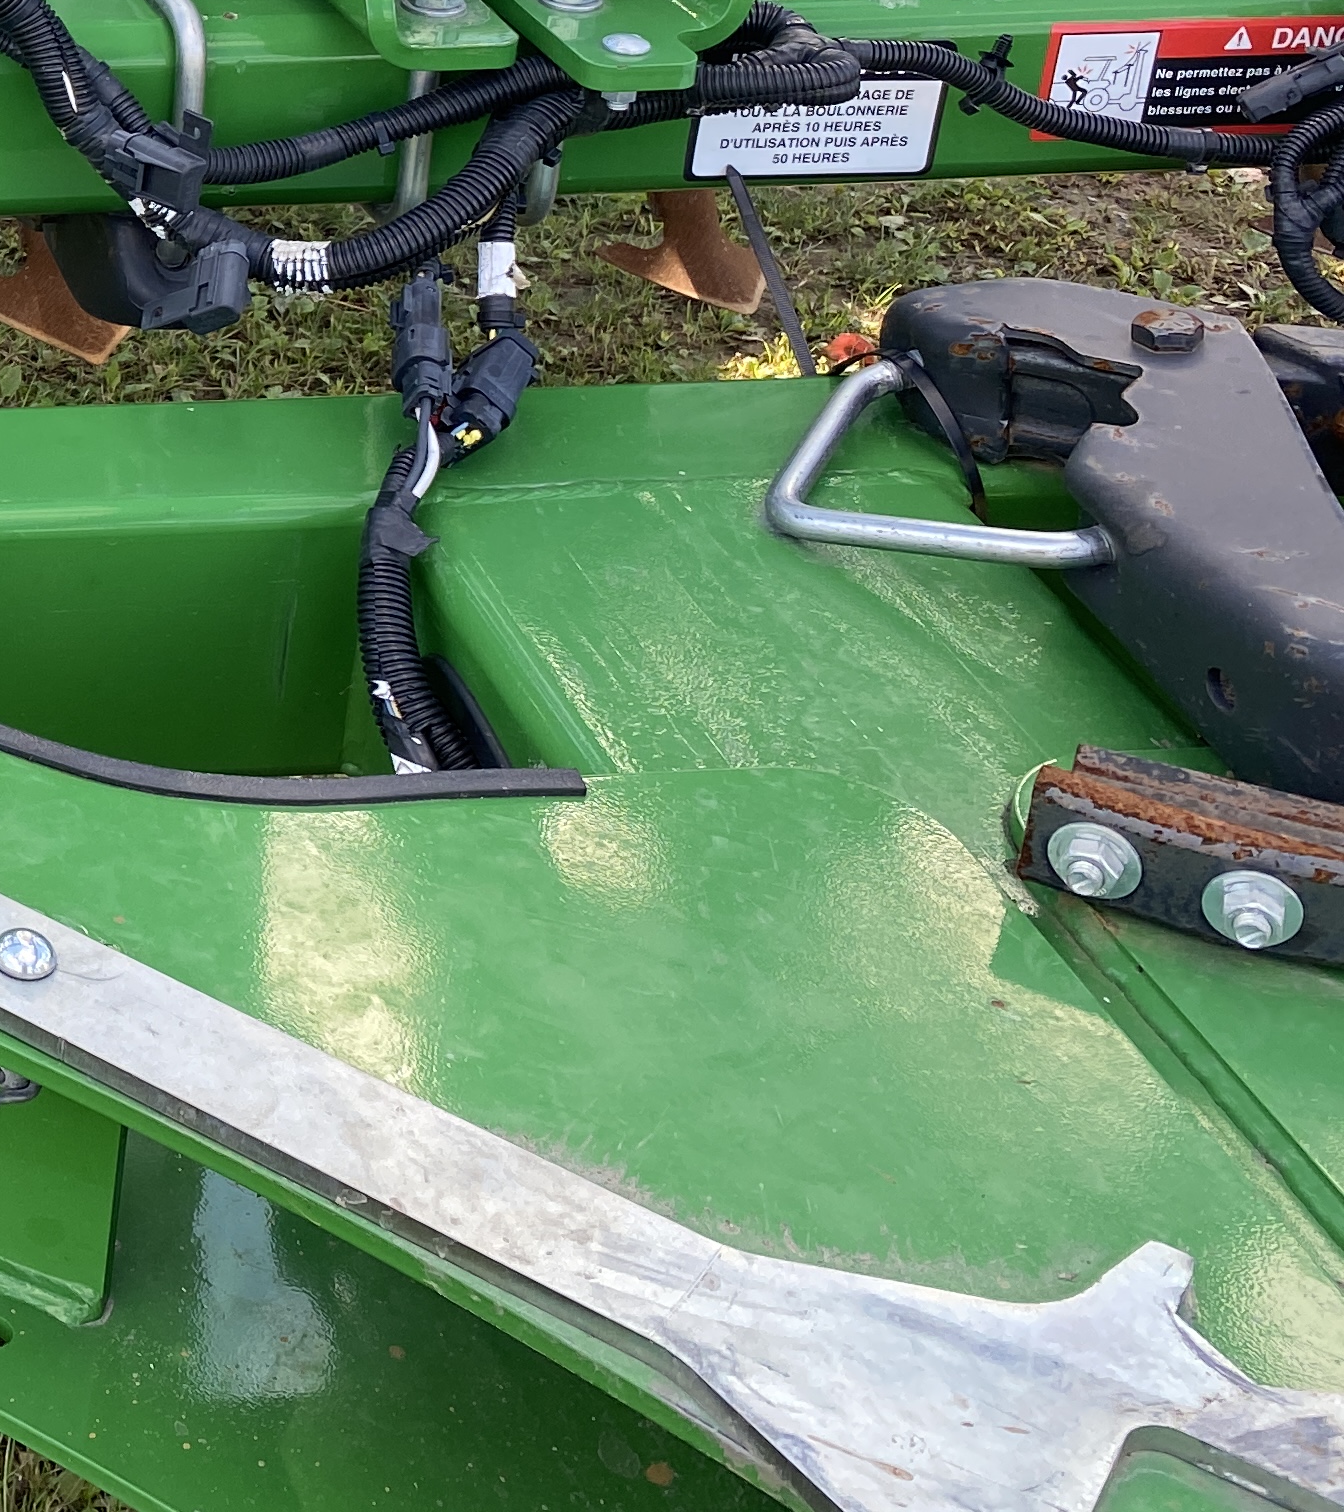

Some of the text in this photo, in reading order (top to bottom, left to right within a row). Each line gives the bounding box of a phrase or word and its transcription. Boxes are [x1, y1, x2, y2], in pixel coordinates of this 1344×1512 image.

[1155, 68, 1173, 79] Ne
[1176, 67, 1243, 80] permettez
[1246, 67, 1270, 79] pas
[895, 89, 915, 100] DE
[1152, 87, 1171, 97] les
[1175, 86, 1214, 98] lignes
[782, 105, 800, 117] LA
[806, 105, 909, 117] BOULONNERIE
[1147, 105, 1212, 116] blessures
[1216, 105, 1233, 114] ou
[752, 119, 881, 133] APRÈS 10 HEURES
[720, 134, 908, 149] D'UTILISATION PUIS APRÈS
[772, 152, 850, 164] 50 HEURES
